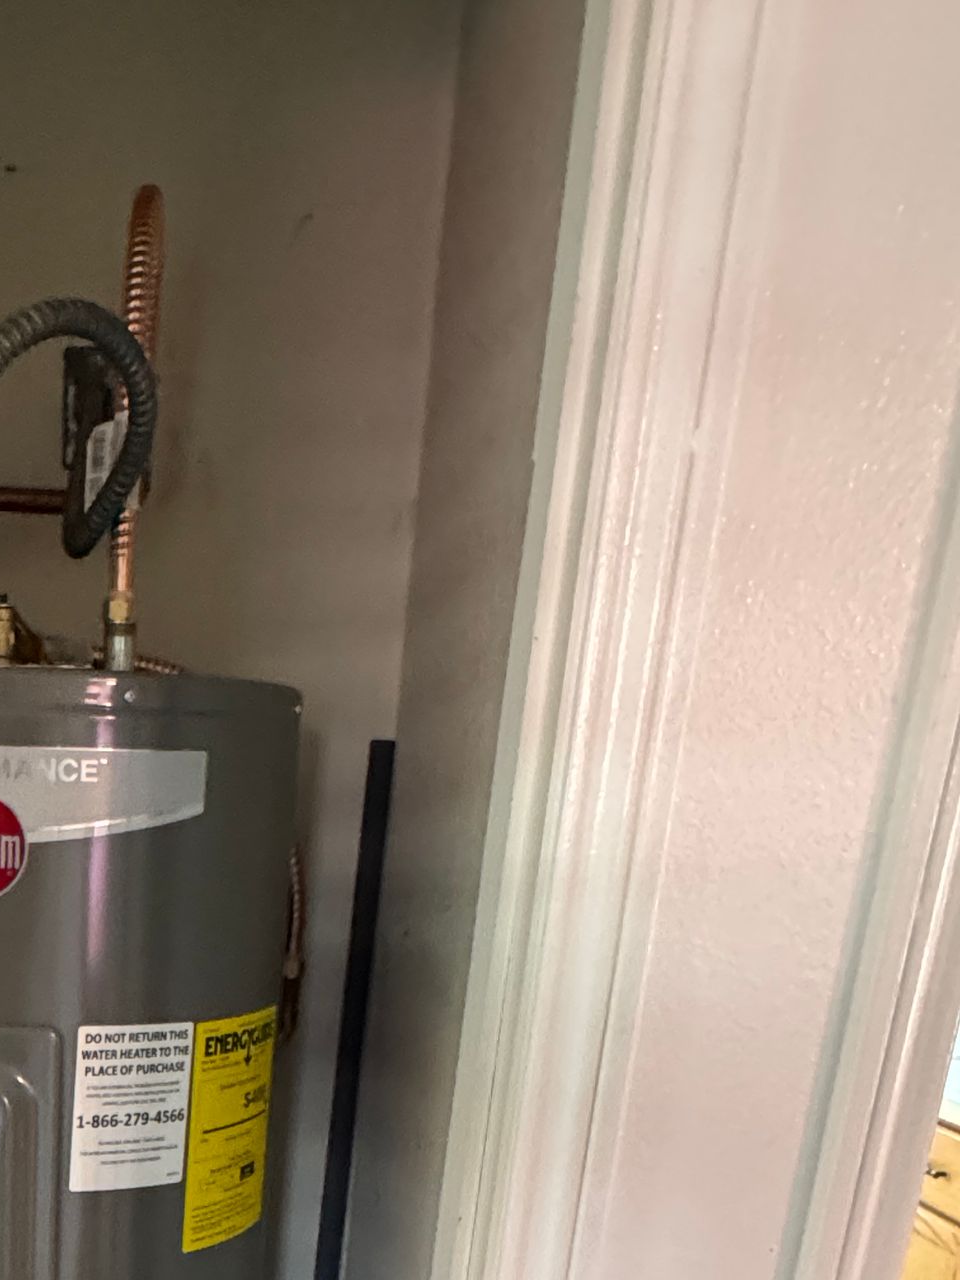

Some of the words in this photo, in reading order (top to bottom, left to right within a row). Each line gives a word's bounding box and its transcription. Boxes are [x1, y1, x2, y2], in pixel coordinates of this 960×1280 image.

[85, 1033, 102, 1044] DO
[104, 1033, 126, 1043] NOT
[128, 1031, 167, 1042] RETURN
[169, 1029, 189, 1040] THIS
[81, 1050, 117, 1060] WATER
[120, 1047, 157, 1059] HEATER
[159, 1046, 171, 1057] TO
[173, 1045, 189, 1056] THE
[85, 1065, 118, 1076] PLACE
[120, 1065, 134, 1076] OF
[136, 1061, 185, 1075] PURCHASE
[76, 1108, 185, 1129] 1-866-279-4566
